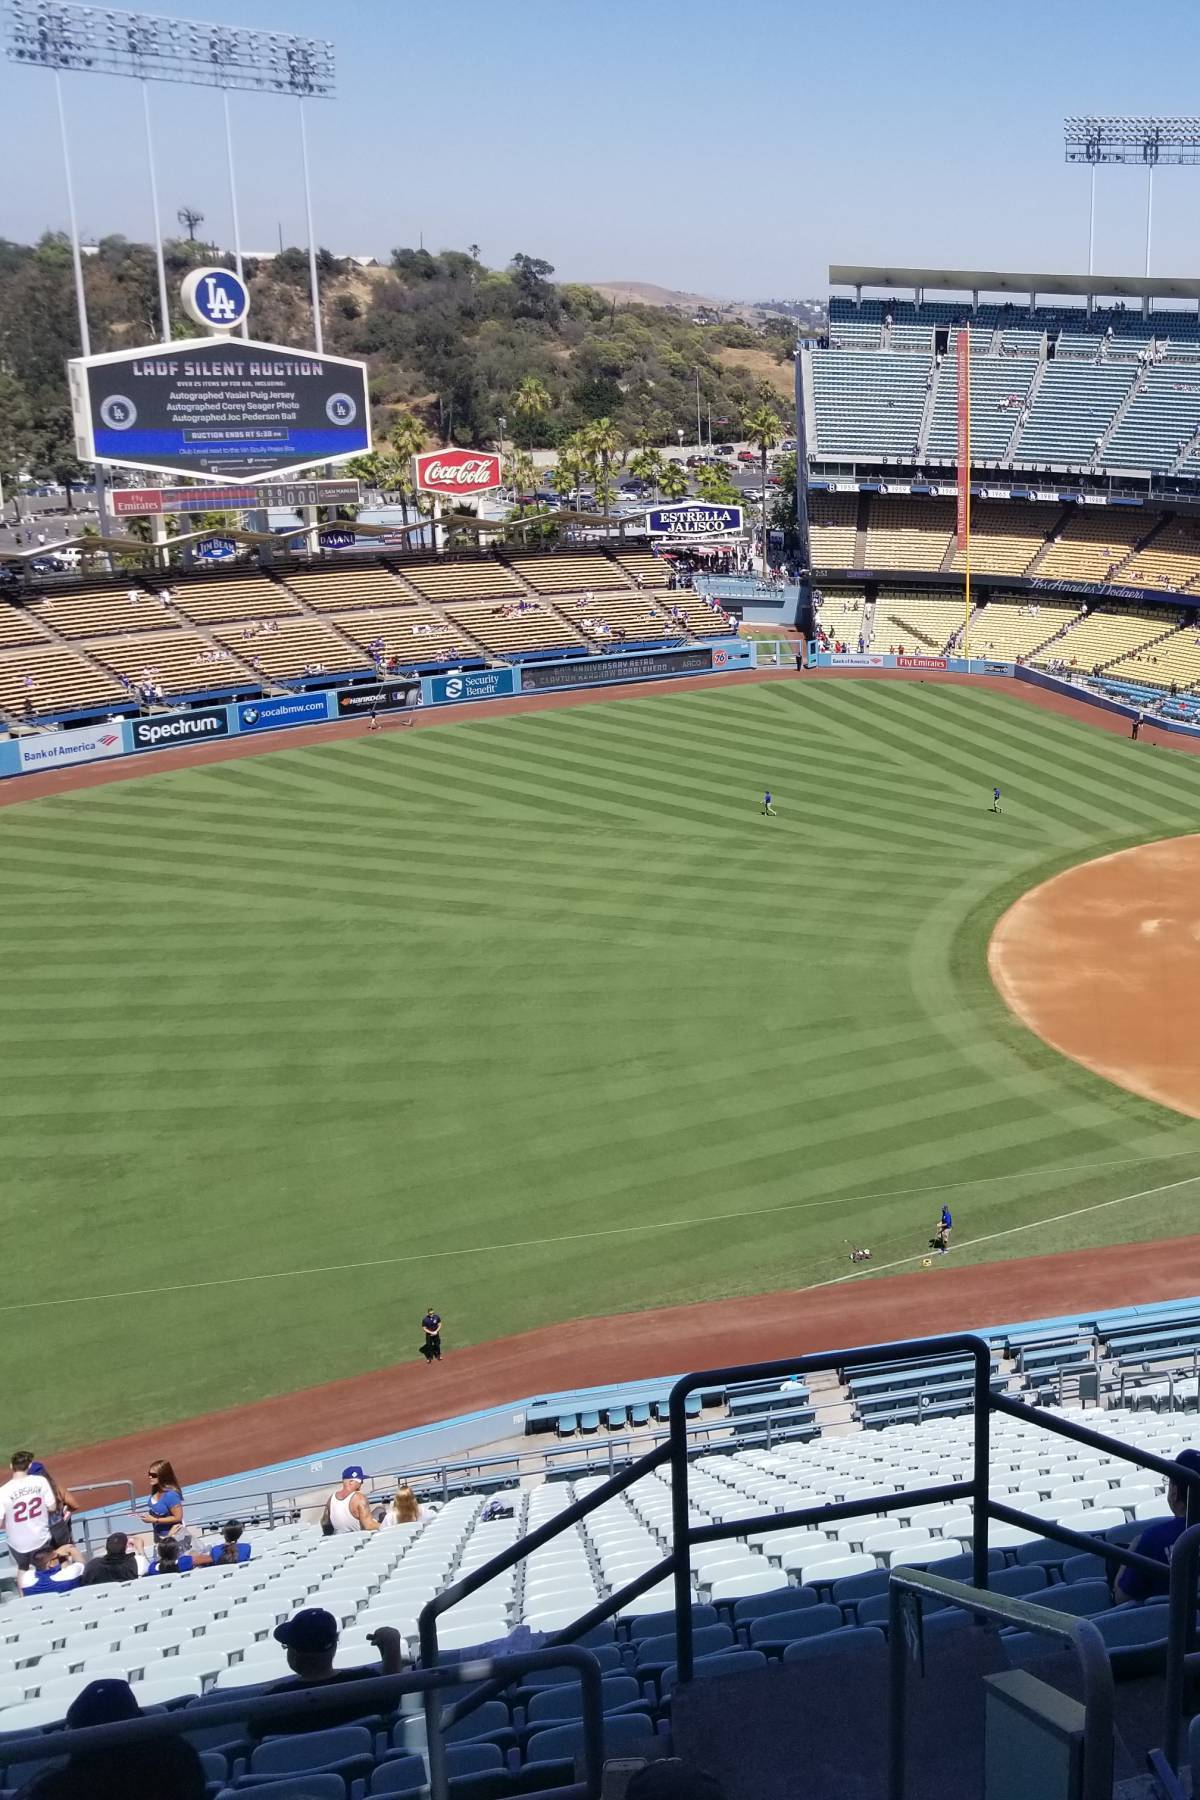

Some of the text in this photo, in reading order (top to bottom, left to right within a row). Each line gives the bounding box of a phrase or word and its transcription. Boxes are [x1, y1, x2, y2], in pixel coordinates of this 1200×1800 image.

[204, 277, 235, 319] LA
[133, 361, 324, 376] LADF SILENT AUCTION
[169, 391, 295, 401] Autographed Yasiel Puig Jersey
[166, 402, 221, 412] Autographed
[222, 402, 246, 412] Corey
[247, 402, 275, 411] Seager
[172, 413, 227, 422] Autographed
[227, 413, 241, 421] Joc
[242, 413, 280, 421] Pederson
[225, 431, 244, 439] ENDS
[424, 459, 494, 485] Coca-Cola
[970, 461, 1052, 473] STADIUM
[1066, 465, 1107, 476] CLUB
[131, 495, 143, 503] Fly
[287, 490, 316, 505] 0 0 0
[117, 502, 159, 511] Emirates
[957, 486, 966, 533] Fly Emirates
[660, 510, 731, 523] ESTRELLA
[667, 521, 724, 533] JALISCO
[320, 533, 354, 546] DASANI
[199, 538, 234, 556] JIM BEAM
[682, 659, 701, 668] ARCO
[715, 654, 725, 663] 76
[899, 657, 945, 668] Fly Emirates
[465, 675, 499, 687] Security
[466, 683, 495, 696] Benefit
[260, 702, 324, 718] socalbmw.com
[138, 717, 218, 743] Spectrum
[24, 742, 96, 762] Bank of America
[13, 1496, 42, 1523] 22
